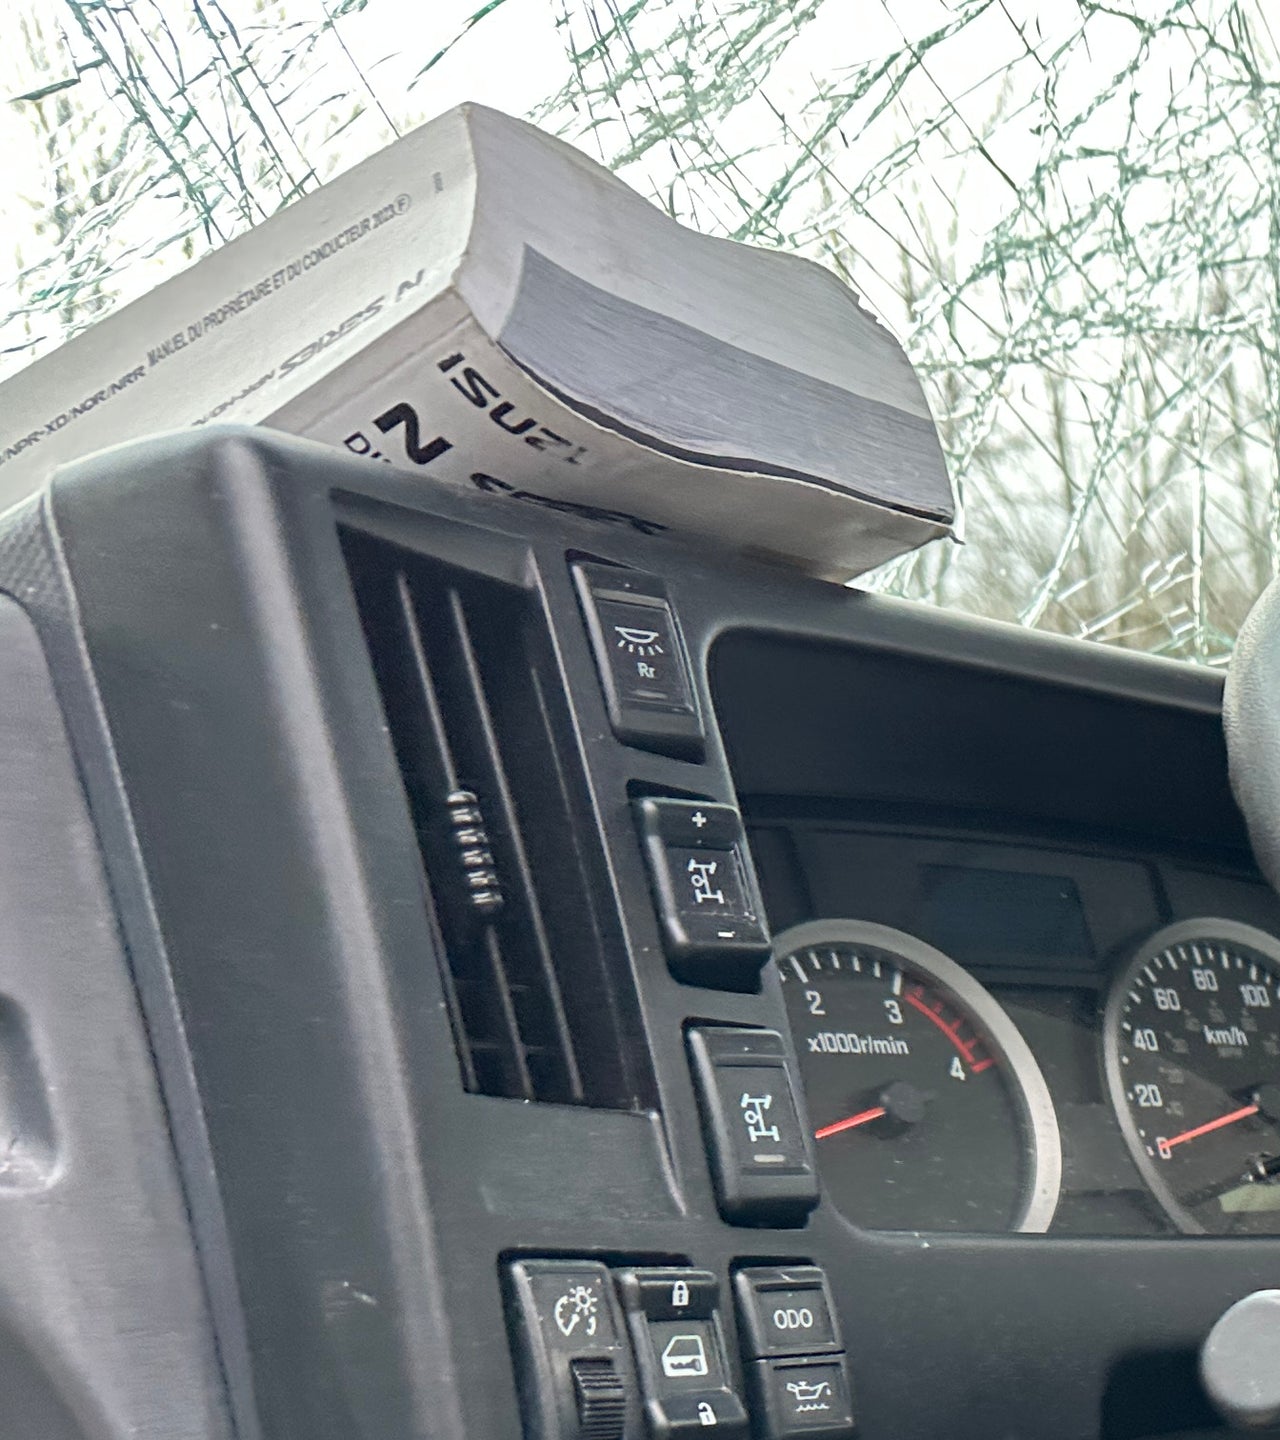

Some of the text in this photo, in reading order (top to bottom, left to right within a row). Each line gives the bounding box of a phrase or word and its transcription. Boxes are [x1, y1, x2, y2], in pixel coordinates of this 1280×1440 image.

[147, 331, 189, 367] MANUEL
[187, 321, 202, 342] DU
[272, 268, 285, 290] ET
[286, 260, 302, 281] DU
[302, 217, 371, 270] CONDUCTEUR
[396, 269, 425, 302] N
[278, 295, 386, 380] SERIES
[373, 402, 454, 465] N
[637, 661, 656, 678] Rr
[805, 990, 826, 1015] 2
[1153, 987, 1182, 1012] 60
[1239, 984, 1271, 1007] 100
[883, 999, 903, 1024] 3
[806, 1032, 910, 1055] x1000r/min
[1134, 1028, 1159, 1051] 40
[1203, 1025, 1249, 1046] km/h
[949, 1056, 966, 1081] 4
[1134, 1084, 1163, 1107] 20
[1156, 1136, 1173, 1160] 0
[773, 1308, 814, 1329] ODO
